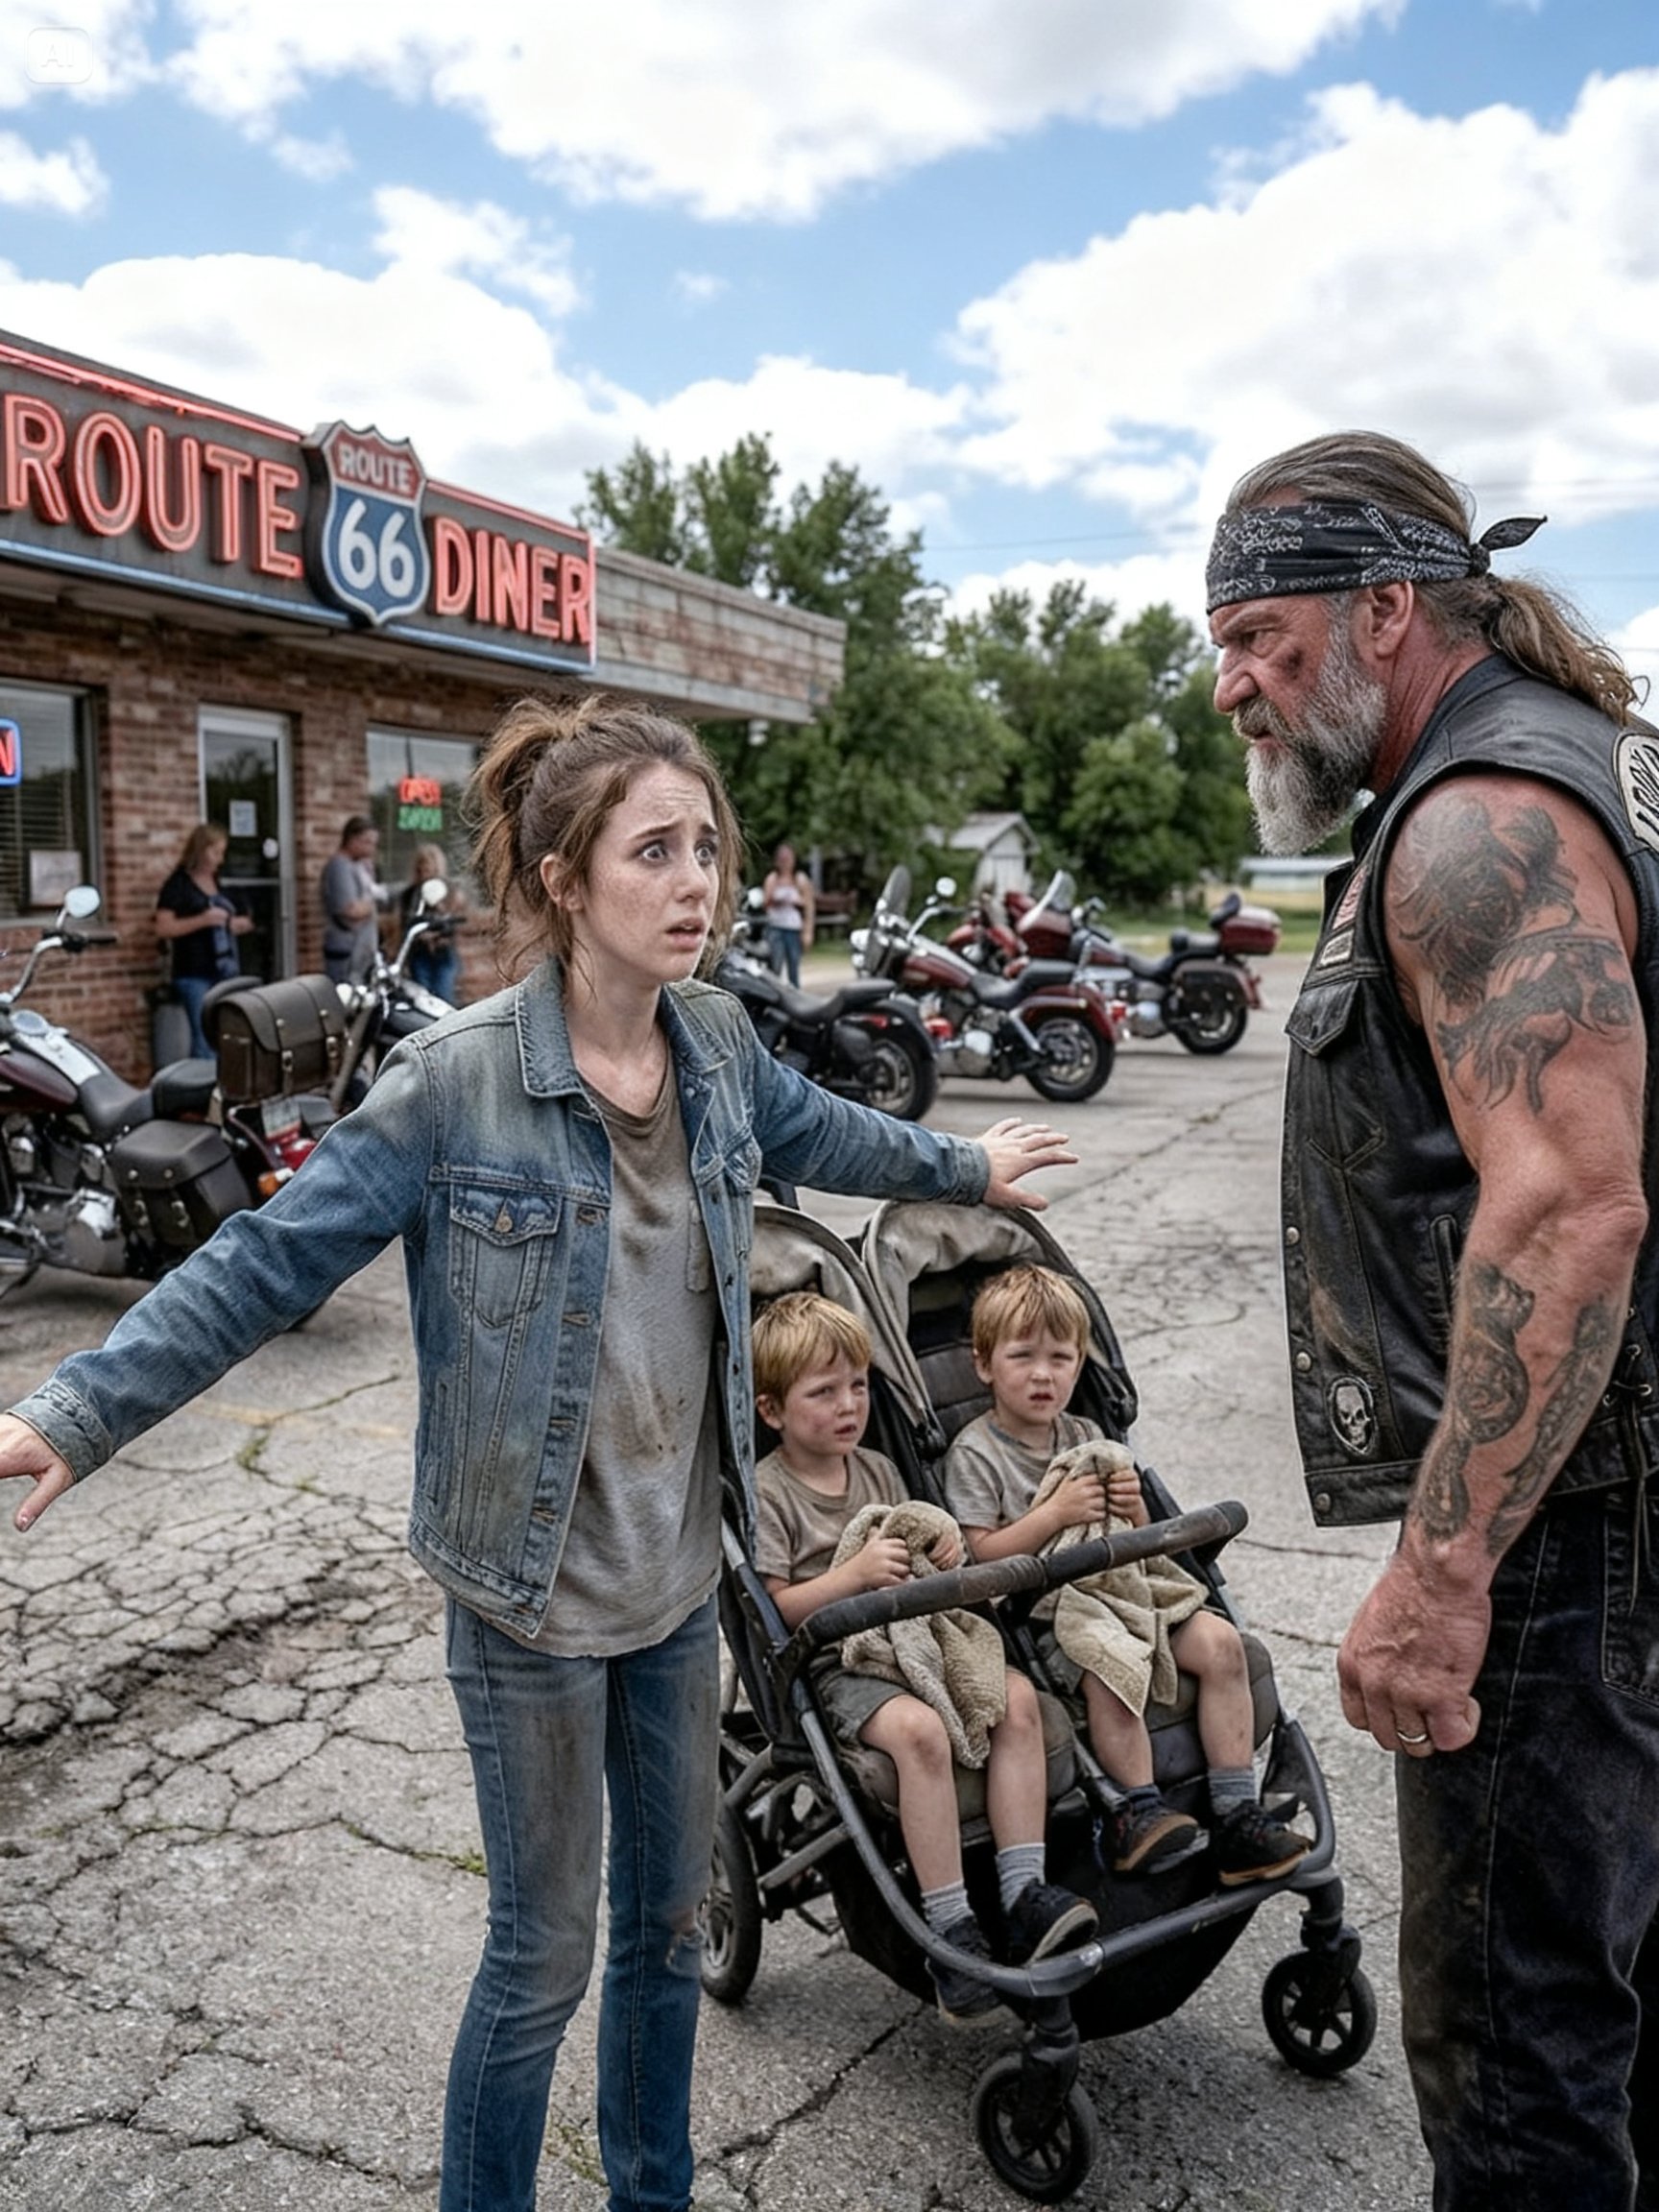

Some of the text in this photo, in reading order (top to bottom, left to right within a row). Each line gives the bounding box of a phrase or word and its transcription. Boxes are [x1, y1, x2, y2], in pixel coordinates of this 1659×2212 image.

[4, 394, 302, 580] ROUTE
[339, 443, 412, 493] ROUTE
[339, 498, 417, 598] 66
[435, 517, 590, 644] DINER
